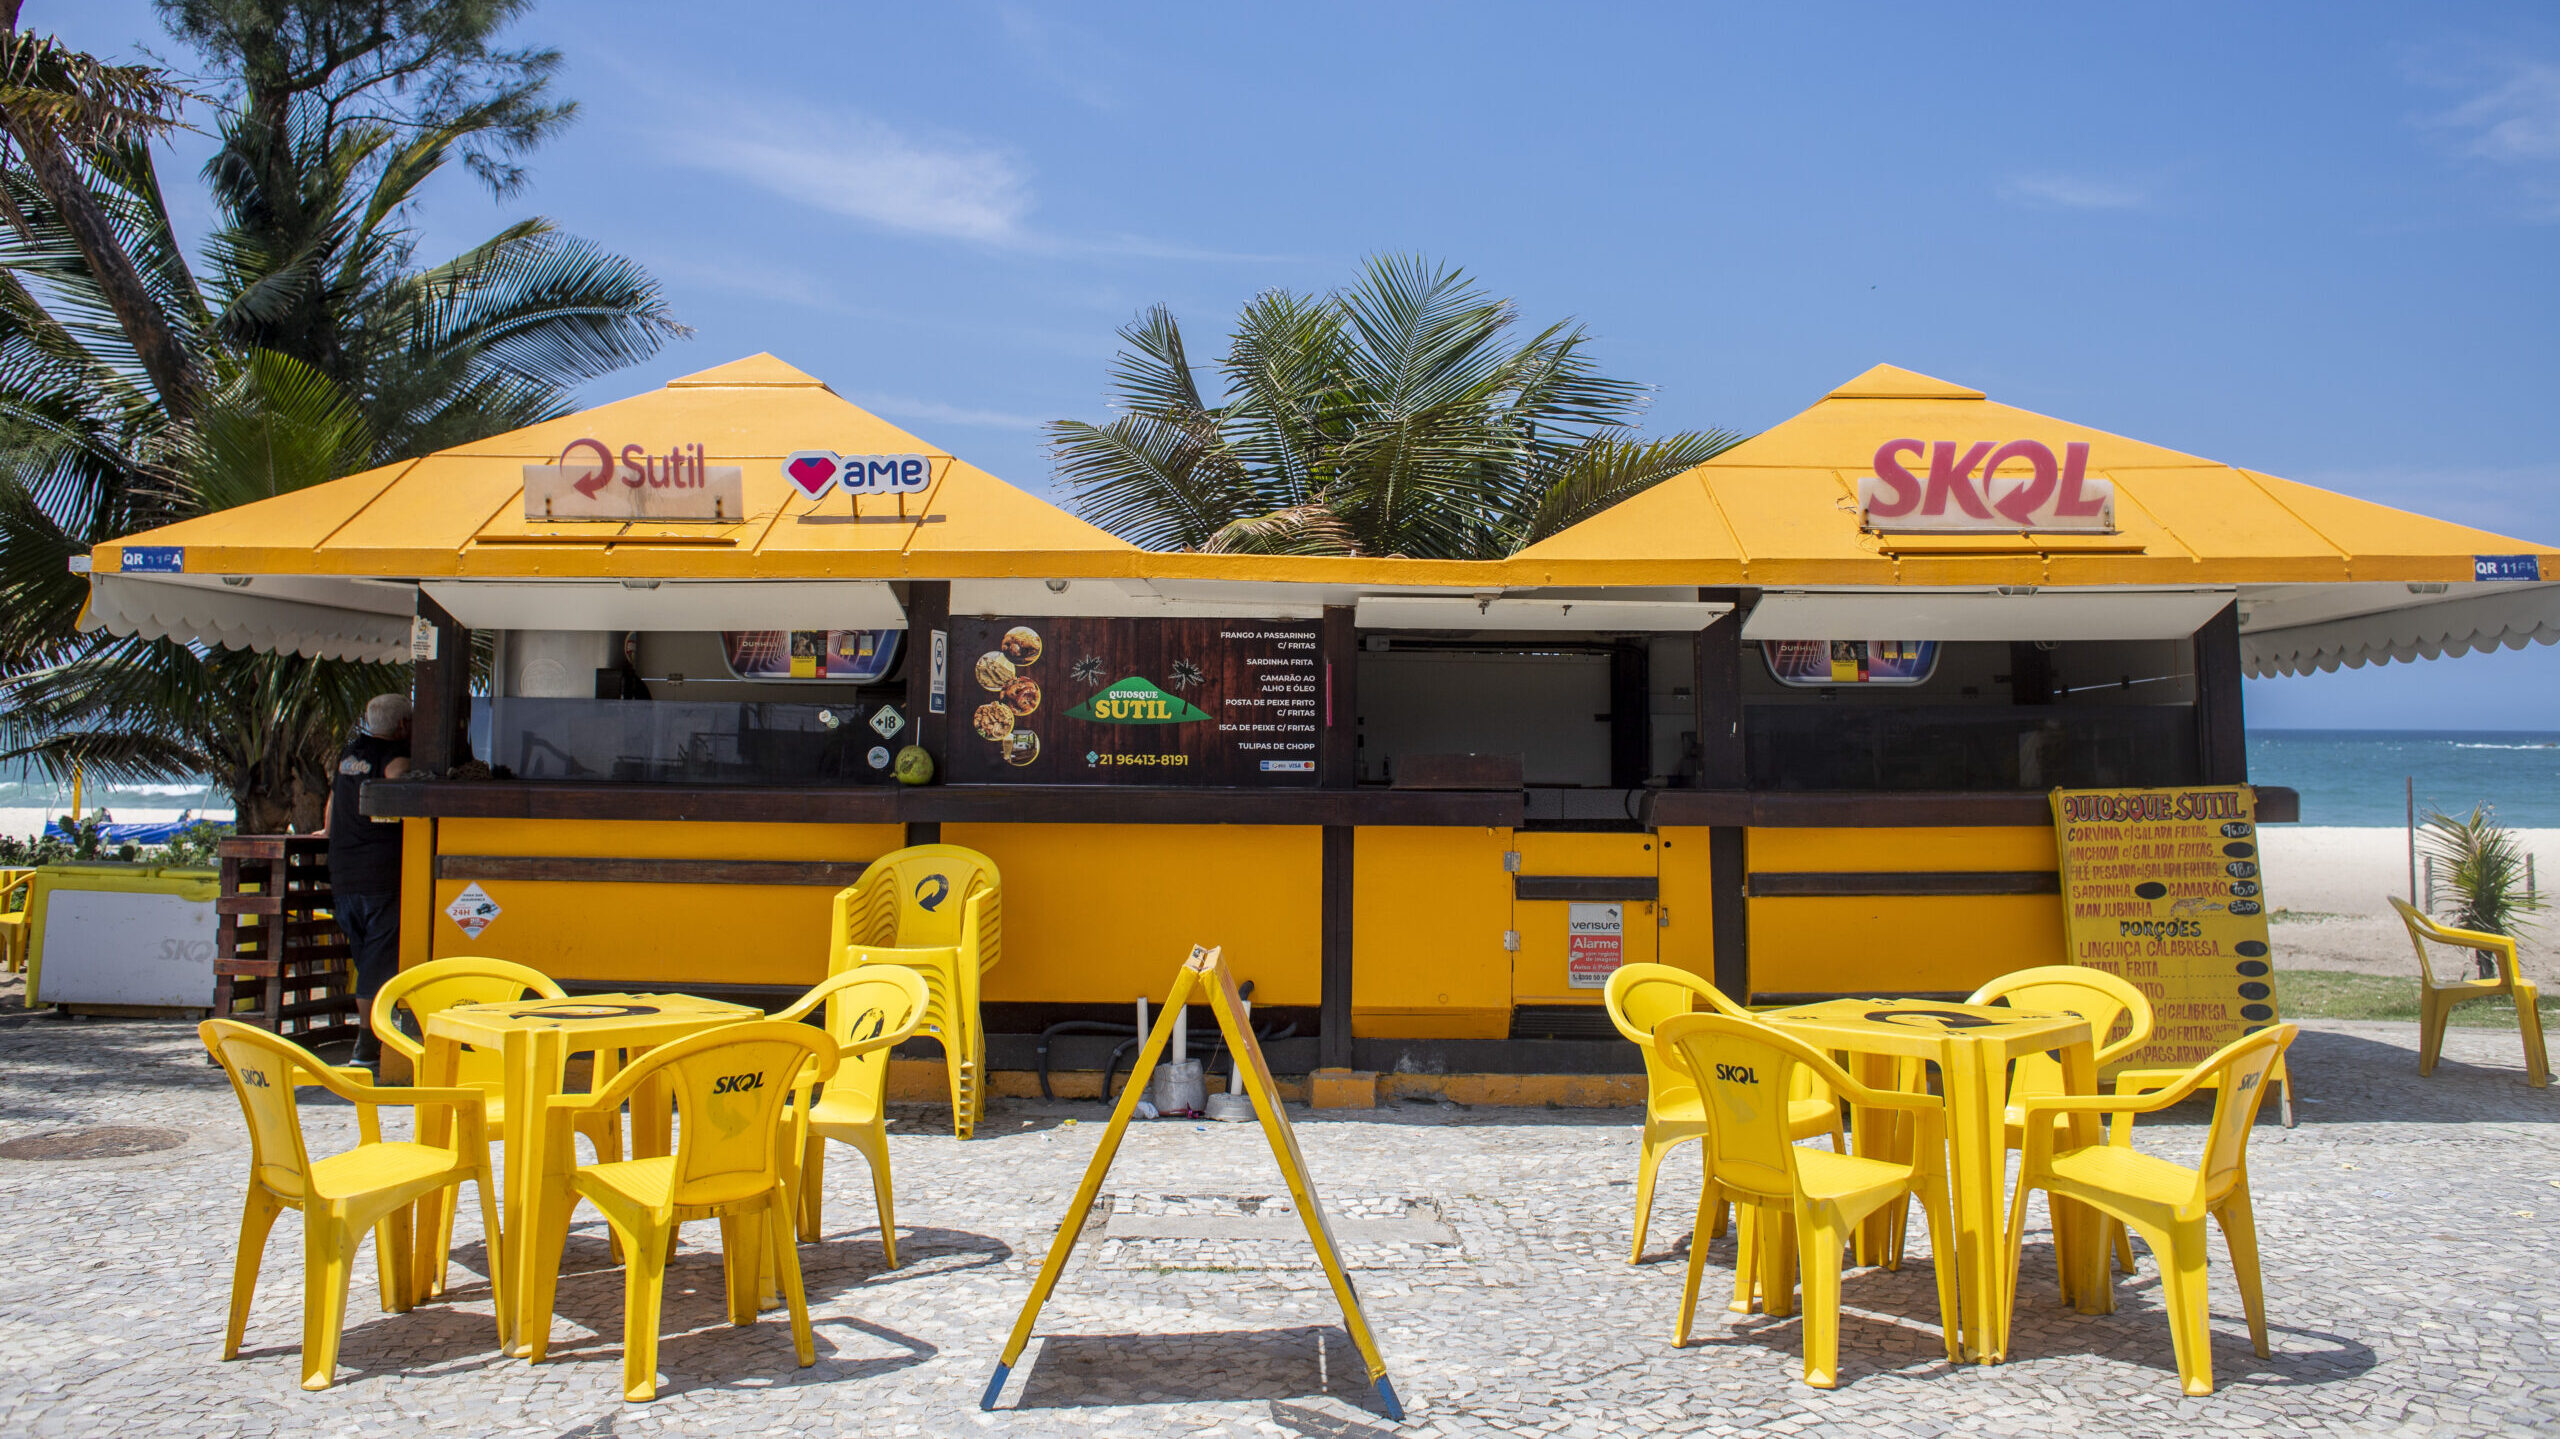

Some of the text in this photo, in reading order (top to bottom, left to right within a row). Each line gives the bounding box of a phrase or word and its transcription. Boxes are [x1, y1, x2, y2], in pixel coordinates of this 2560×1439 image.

[621, 443, 705, 490] Sutil
[1867, 438, 2107, 526] SKOL
[123, 553, 143, 565] QR
[2476, 561, 2497, 574] QR
[1264, 632, 1316, 640] PASSARINHO
[1278, 642, 1286, 651] C/
[1260, 673, 1301, 682] CAMARÃO
[1293, 683, 1316, 692] ÓLEO
[1109, 691, 1158, 699] QUIOSQUE
[1095, 700, 1172, 719] SUTIL
[1277, 709, 1286, 717] C/
[1277, 724, 1286, 733] C/
[1287, 743, 1316, 751] CHOPP
[1100, 755, 1189, 766] 21 96413-8191
[2064, 792, 2247, 823] QUIOSQUE SUTIL
[2068, 825, 2123, 842] CORVINA
[2174, 824, 2208, 839] FRITAS
[2177, 843, 2214, 858] FRITAS
[2182, 862, 2219, 878] FRITAS
[2072, 884, 2131, 899] SARDINHA
[1572, 922, 1620, 930] verisure
[1573, 937, 1619, 949] Alarme
[2079, 940, 2220, 961] LINGUIÇA CALABRESA
[2126, 961, 2159, 977] FRITA
[1716, 1063, 1759, 1085] SKOL
[713, 1071, 765, 1094] SKOL
